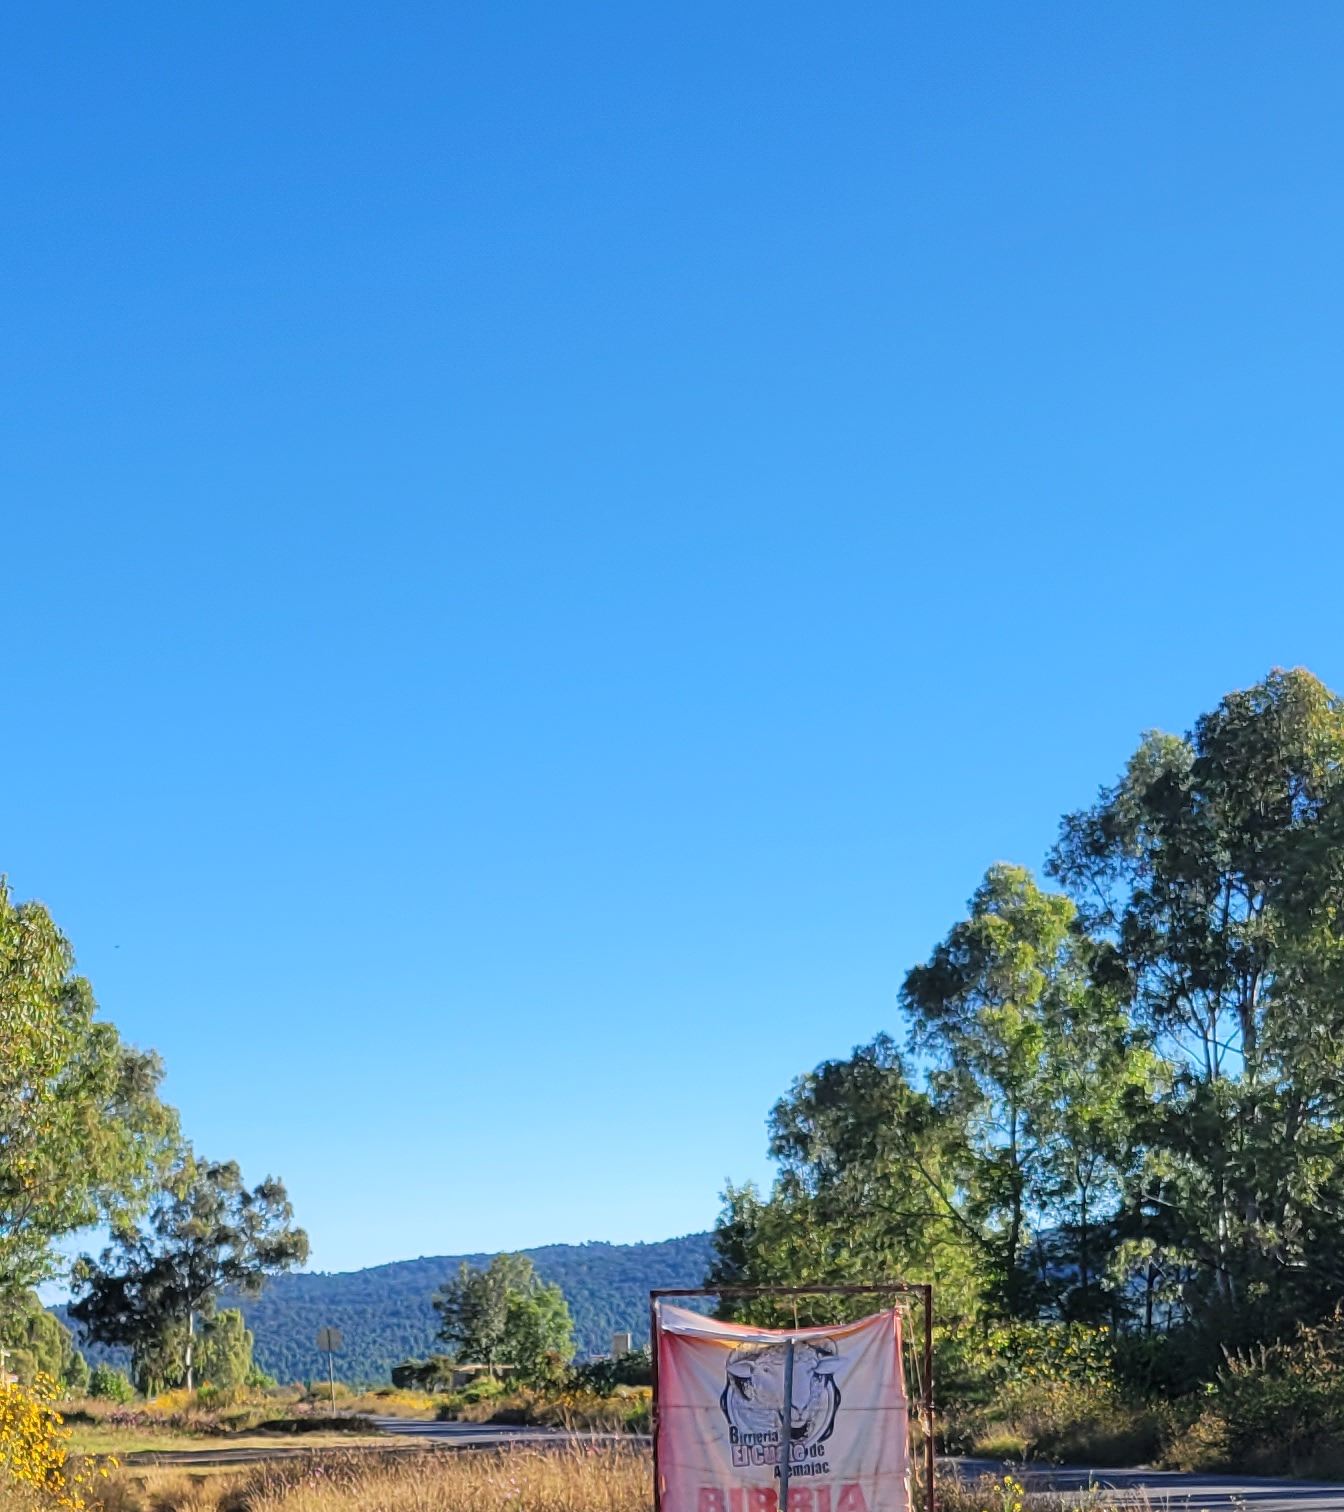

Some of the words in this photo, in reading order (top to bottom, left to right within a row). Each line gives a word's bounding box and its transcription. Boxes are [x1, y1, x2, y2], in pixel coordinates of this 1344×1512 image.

[731, 1443, 751, 1467] El
[809, 1443, 825, 1458] de
[773, 1461, 830, 1479] Aemajac
